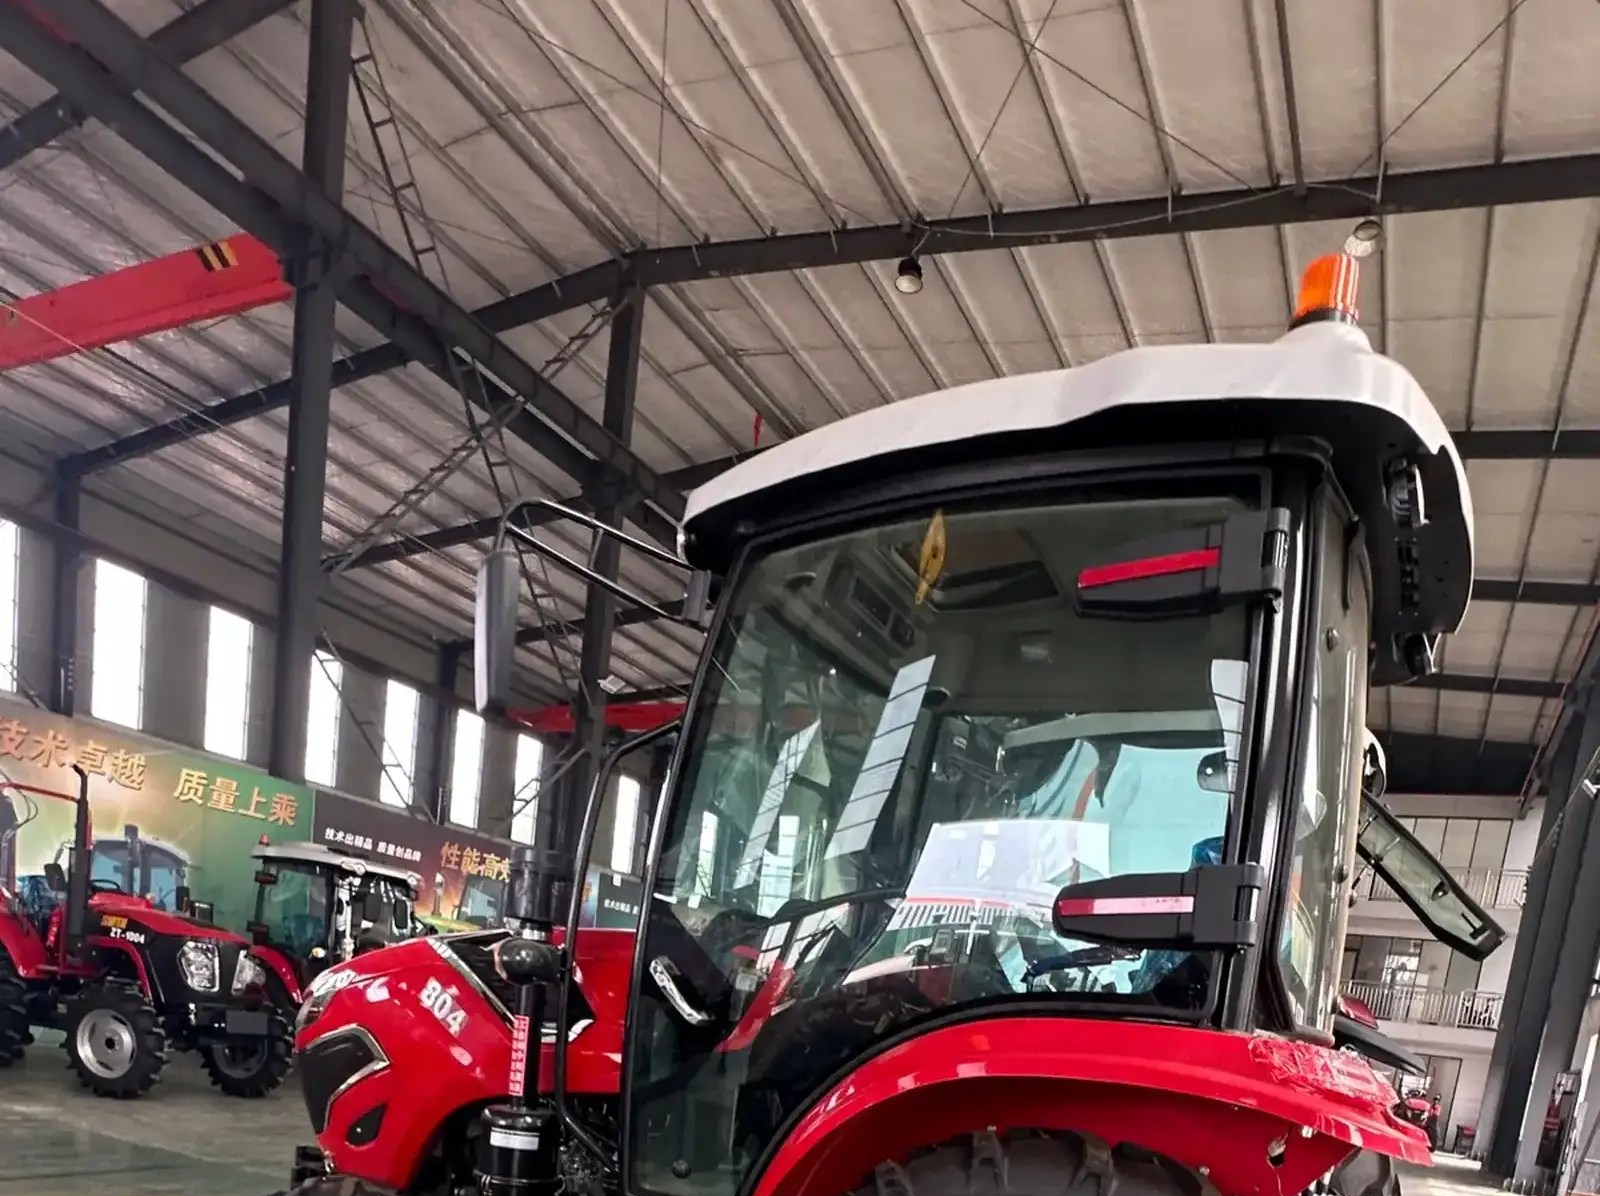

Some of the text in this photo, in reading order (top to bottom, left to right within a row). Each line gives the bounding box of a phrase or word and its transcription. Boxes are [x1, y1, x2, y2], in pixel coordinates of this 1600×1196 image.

[173, 767, 298, 825] 质量上乘
[418, 976, 468, 1038] 804
